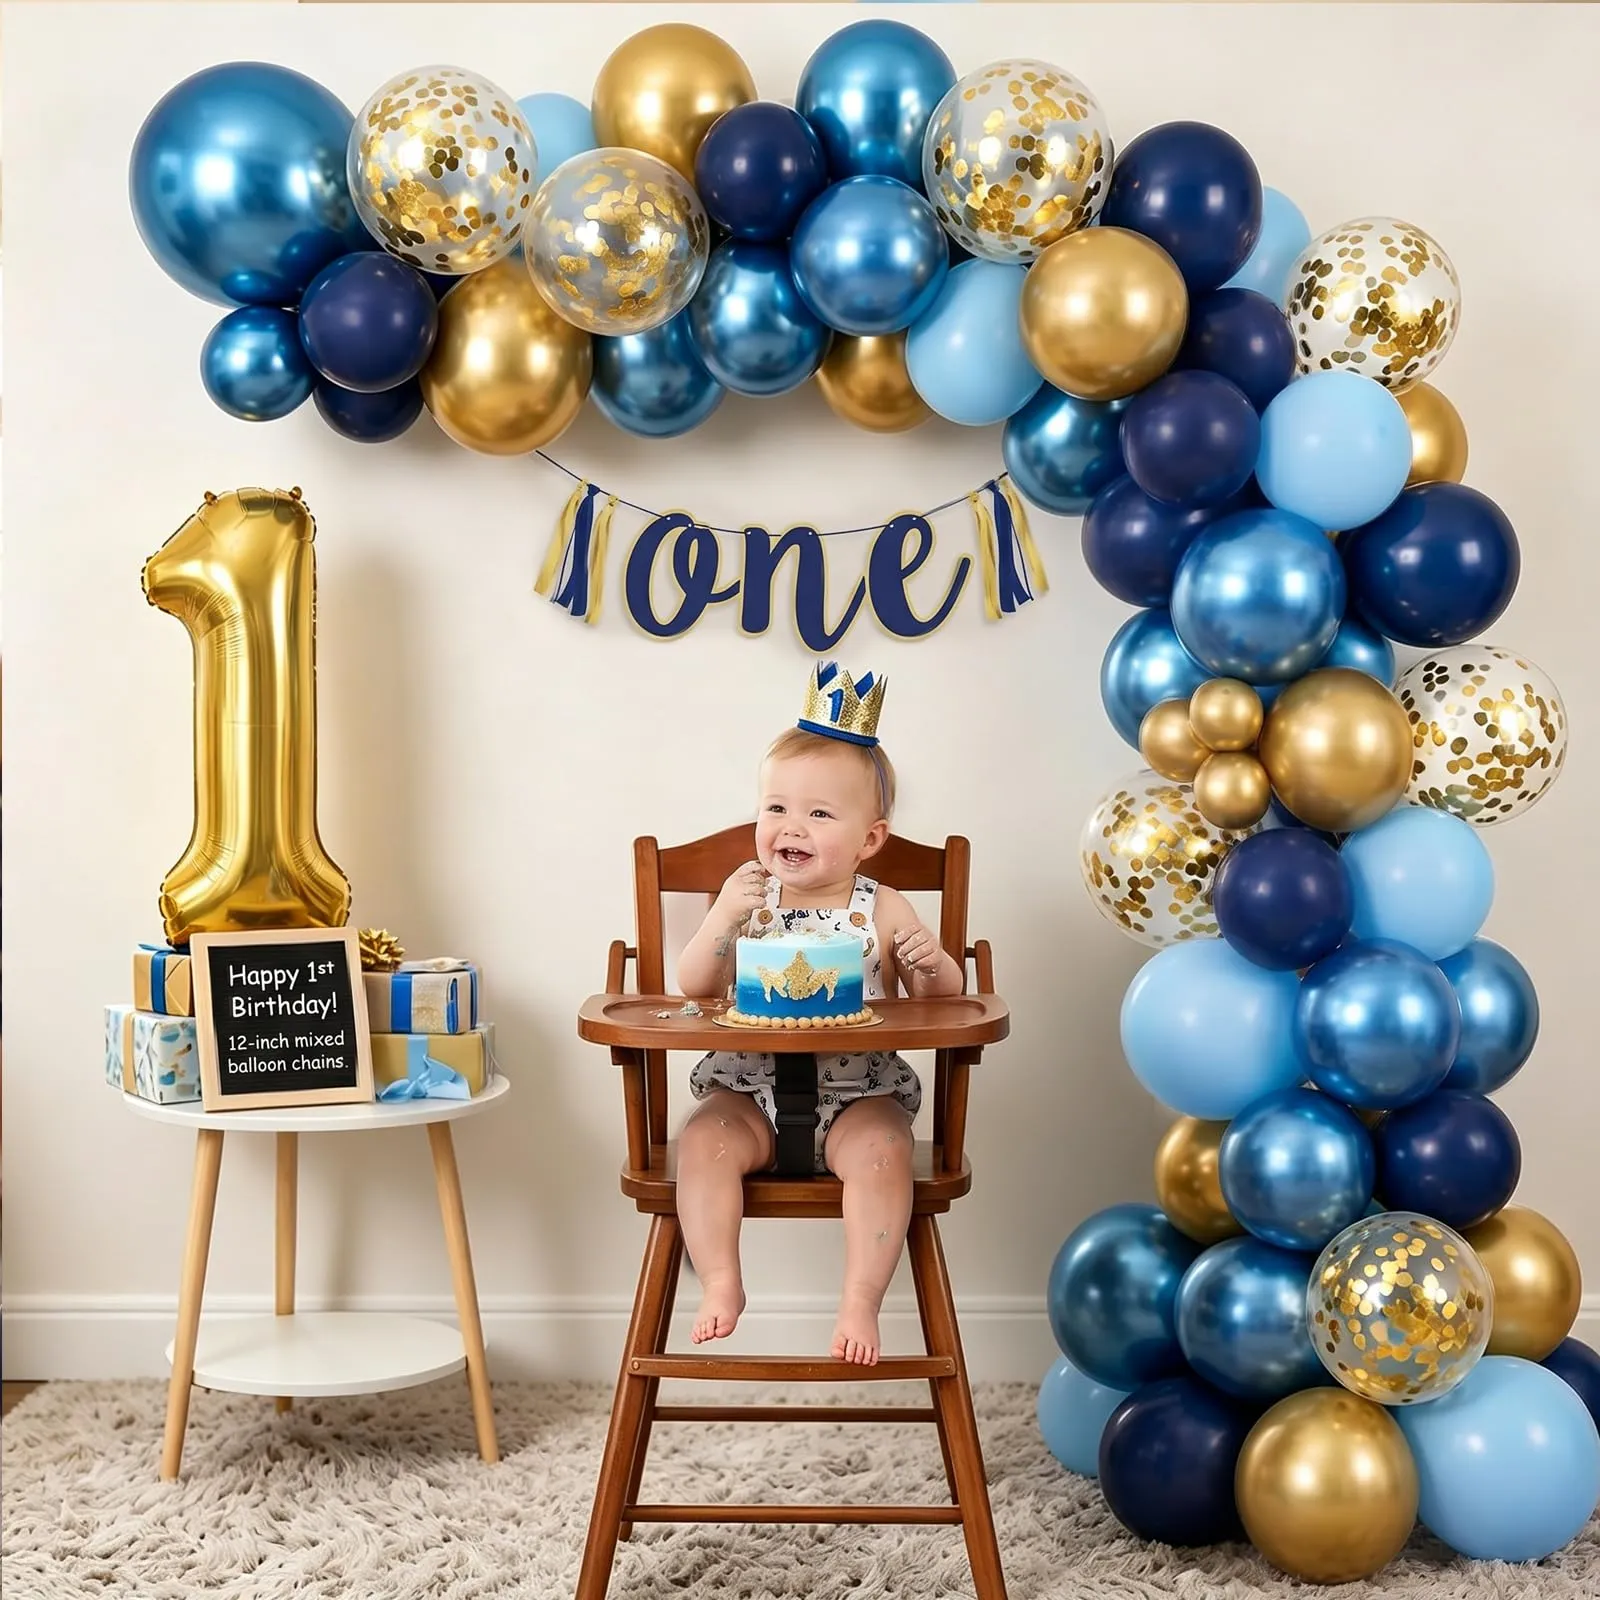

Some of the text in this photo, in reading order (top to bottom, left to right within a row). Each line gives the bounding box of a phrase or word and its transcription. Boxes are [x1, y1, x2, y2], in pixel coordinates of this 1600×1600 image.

[626, 511, 972, 652] one
[141, 486, 352, 945] 1
[827, 688, 844, 723] 1
[229, 960, 335, 992] Happy 1st
[232, 991, 338, 1019] Birthday!
[228, 1029, 345, 1051] 12-inch mixed
[228, 1054, 349, 1074] balloon chains.
